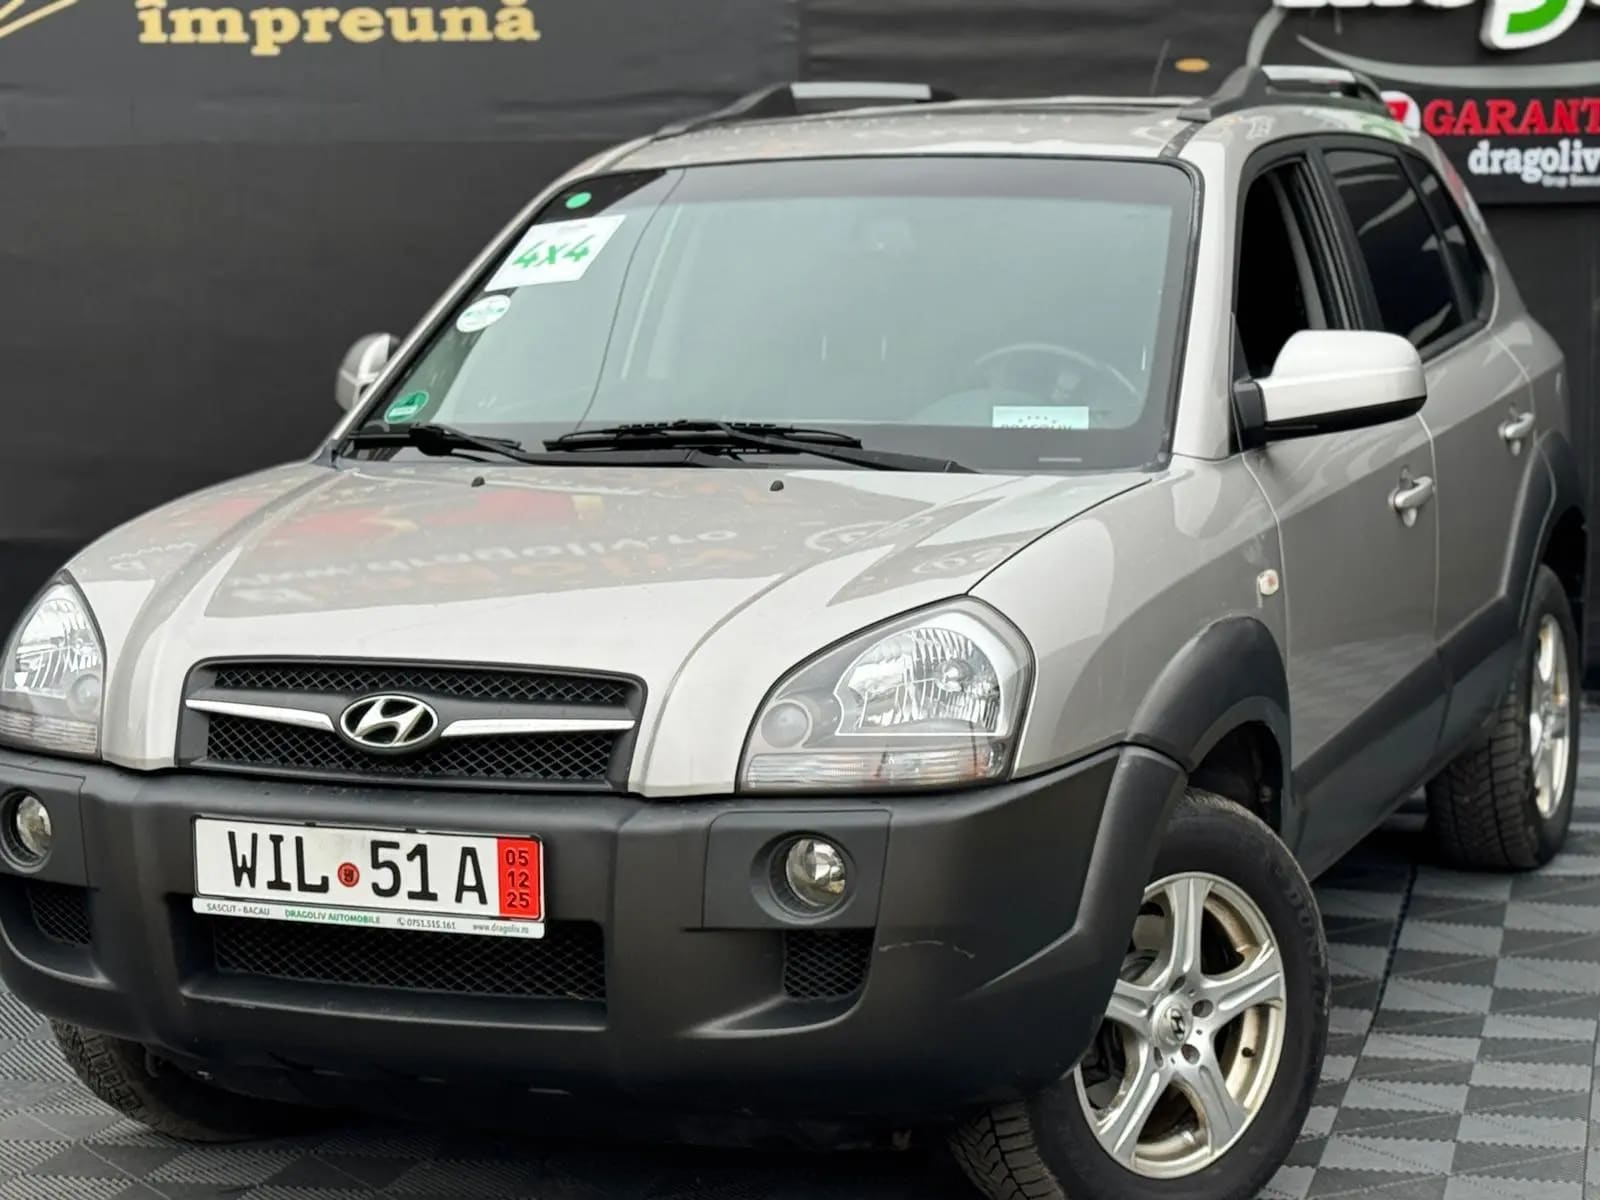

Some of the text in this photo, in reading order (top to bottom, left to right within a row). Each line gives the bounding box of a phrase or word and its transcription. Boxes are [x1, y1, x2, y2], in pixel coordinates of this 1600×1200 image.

[135, 0, 540, 56] împreună
[1423, 98, 1600, 136] GARANT
[1467, 138, 1600, 184] dragoliv
[227, 830, 488, 905] WIL 51 A
[505, 848, 529, 867] 05
[507, 870, 530, 888] 12
[506, 891, 530, 909] 25
[284, 909, 326, 921] DRAGOLIV
[328, 914, 381, 925] AUTOMOBILE
[406, 919, 456, 931] 0751.515.161
[472, 923, 529, 935] www.dragoliv.ro
